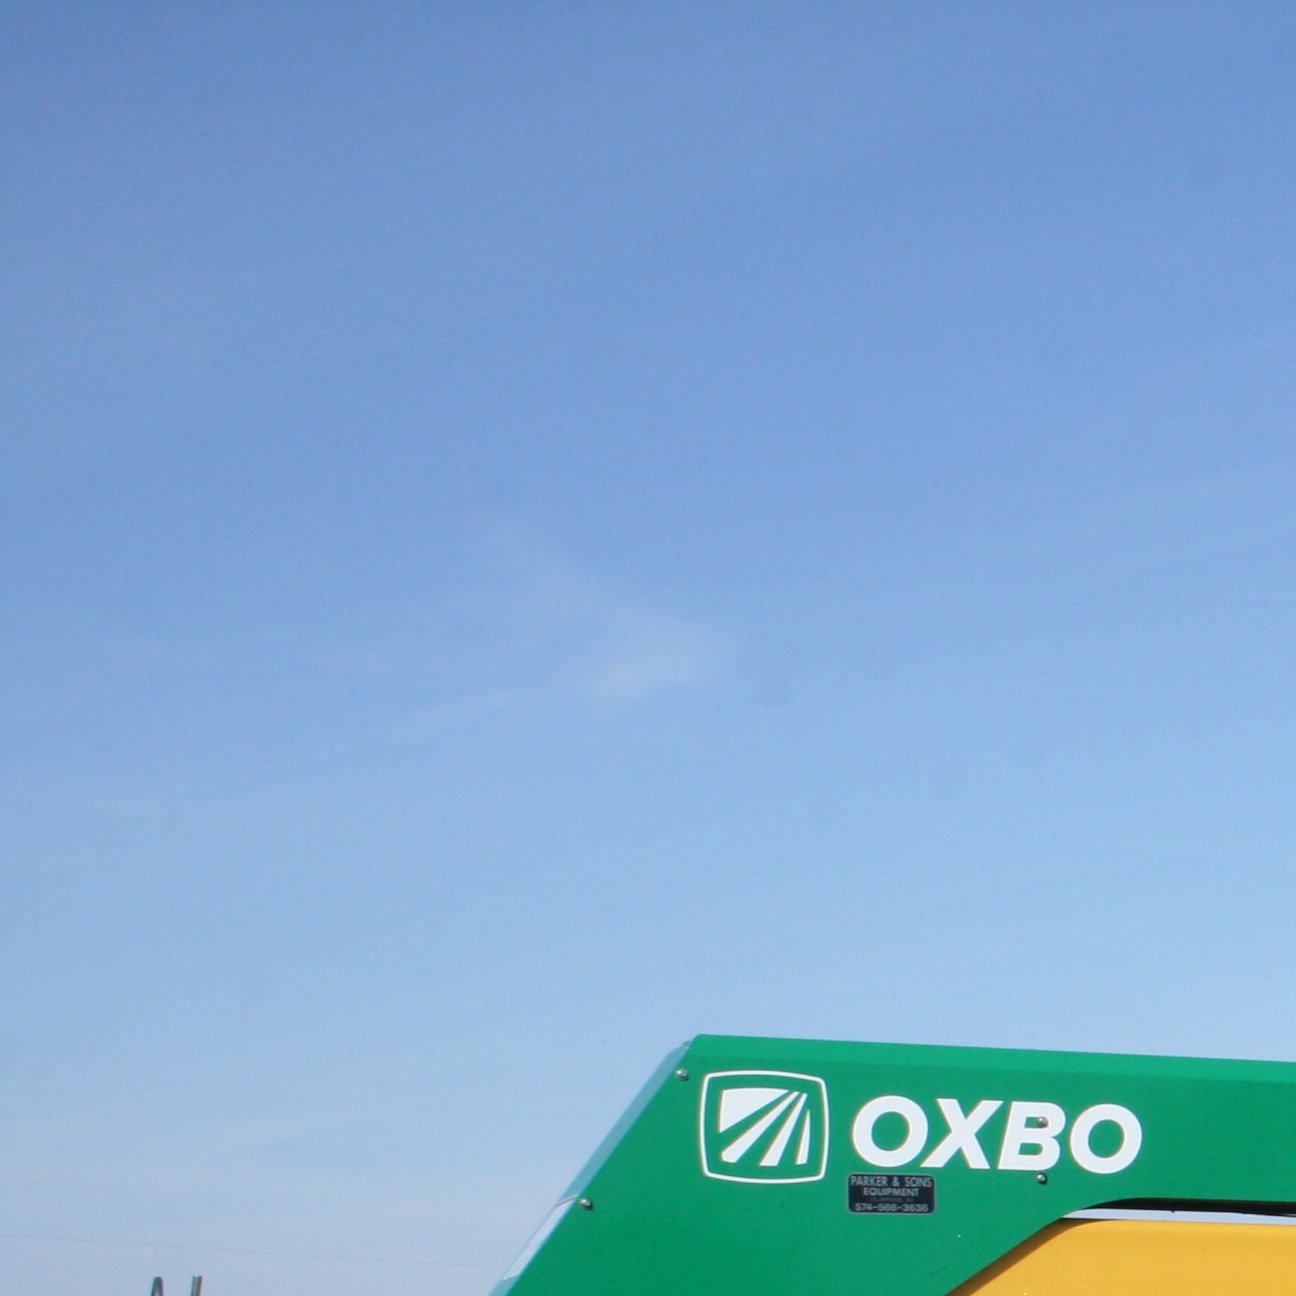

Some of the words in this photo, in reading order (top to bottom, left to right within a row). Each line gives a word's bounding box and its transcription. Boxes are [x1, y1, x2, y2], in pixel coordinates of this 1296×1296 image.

[852, 1095, 1143, 1175] OXBO
[850, 1176, 888, 1187] PARKER
[892, 1176, 900, 1187] &
[904, 1177, 932, 1188] SONS
[863, 1187, 919, 1197] EQUIPMENT
